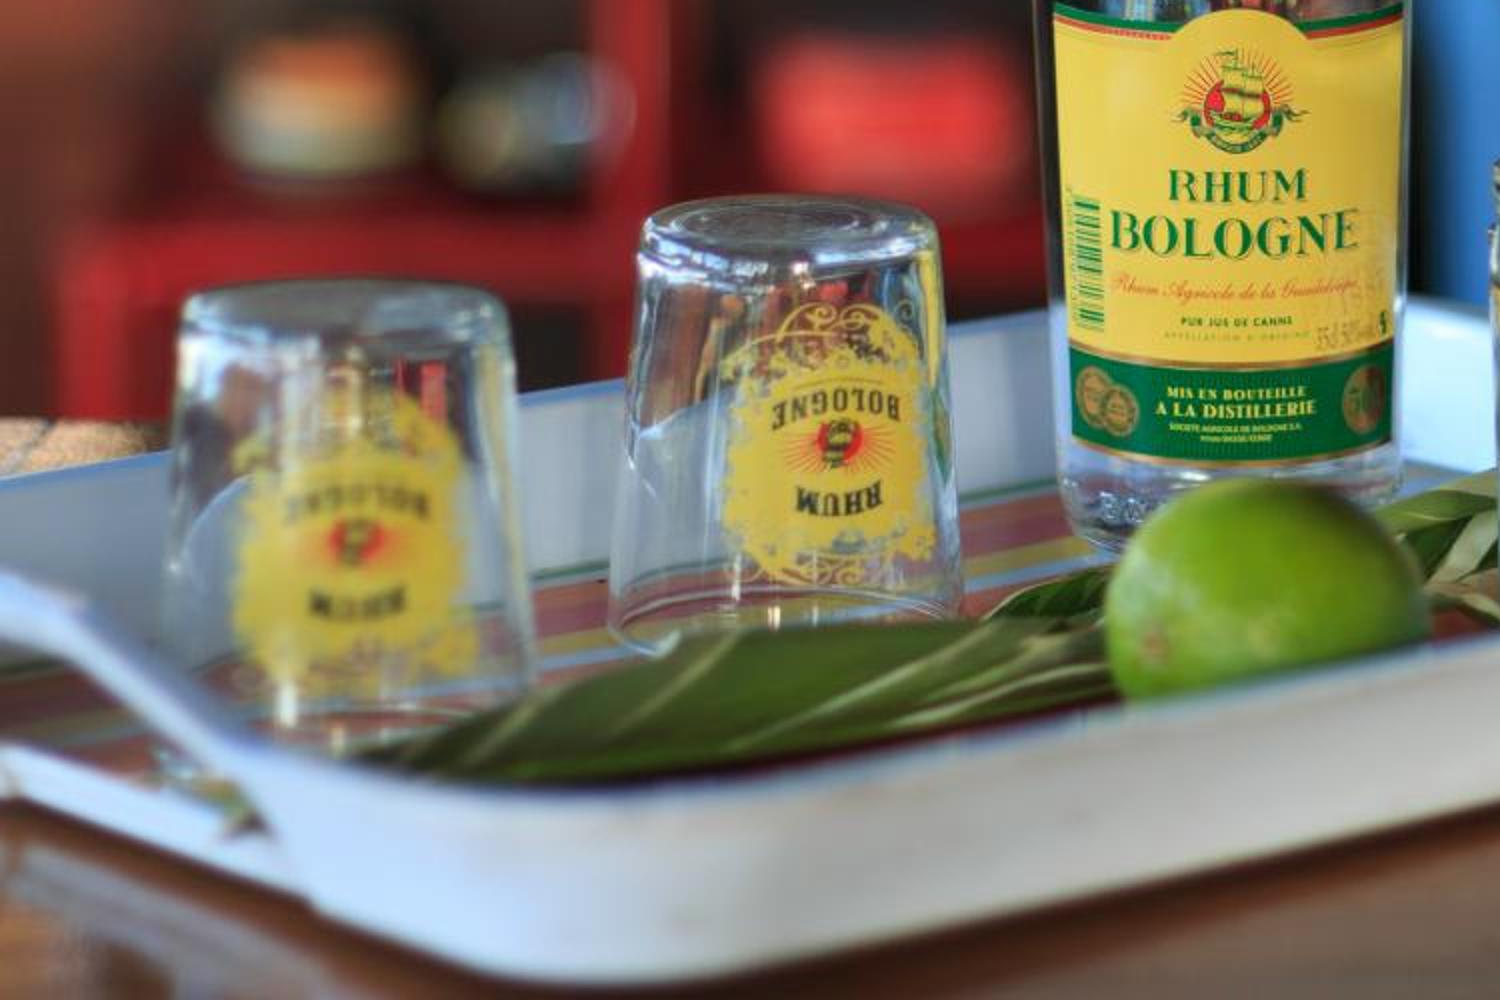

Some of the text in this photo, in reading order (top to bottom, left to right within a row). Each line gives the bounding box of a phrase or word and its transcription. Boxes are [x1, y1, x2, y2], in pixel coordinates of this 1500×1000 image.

[1168, 168, 1308, 203] RHUM
[1110, 208, 1359, 259] BOLOGNE
[1238, 280, 1257, 299] de
[1260, 280, 1277, 299] la
[1181, 315, 1293, 328] PUR JUS DE CANNE
[1167, 385, 1307, 400] MIS EN BOUTEILLE
[771, 387, 901, 431] BOLOGNE
[1155, 400, 1318, 419] A LA DISTILLERIE
[795, 480, 884, 517] RHUM
